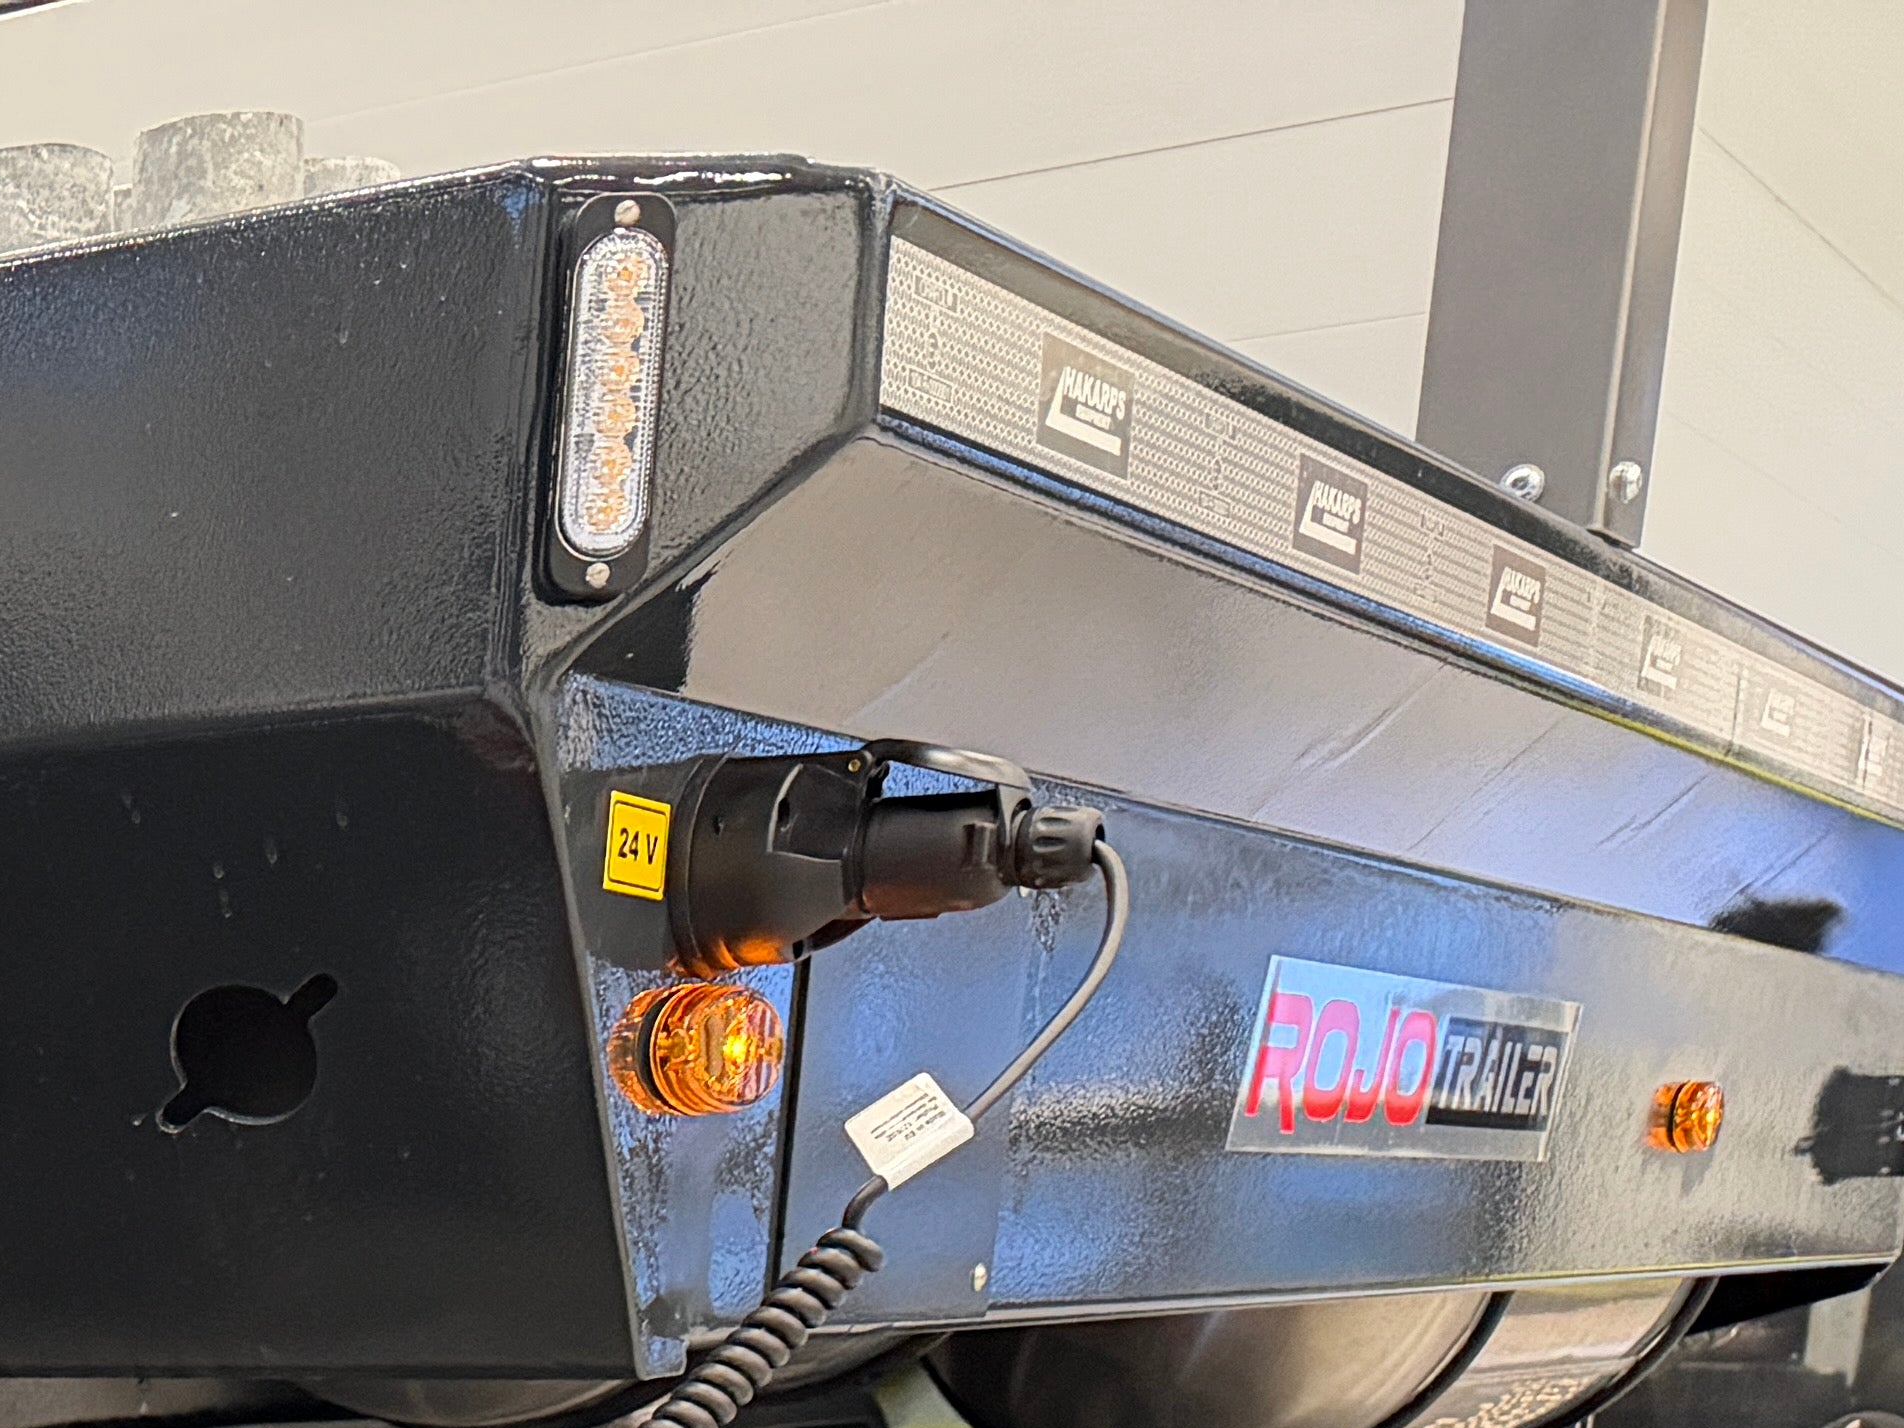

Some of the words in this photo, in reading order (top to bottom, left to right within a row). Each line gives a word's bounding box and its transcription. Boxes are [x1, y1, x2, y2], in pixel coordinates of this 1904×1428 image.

[1064, 366, 1127, 421] HAKARPS
[617, 827, 640, 861] 24
[646, 832, 659, 865] V
[1244, 992, 1437, 1134] ROJO
[1438, 1032, 1559, 1116] TRAILER
